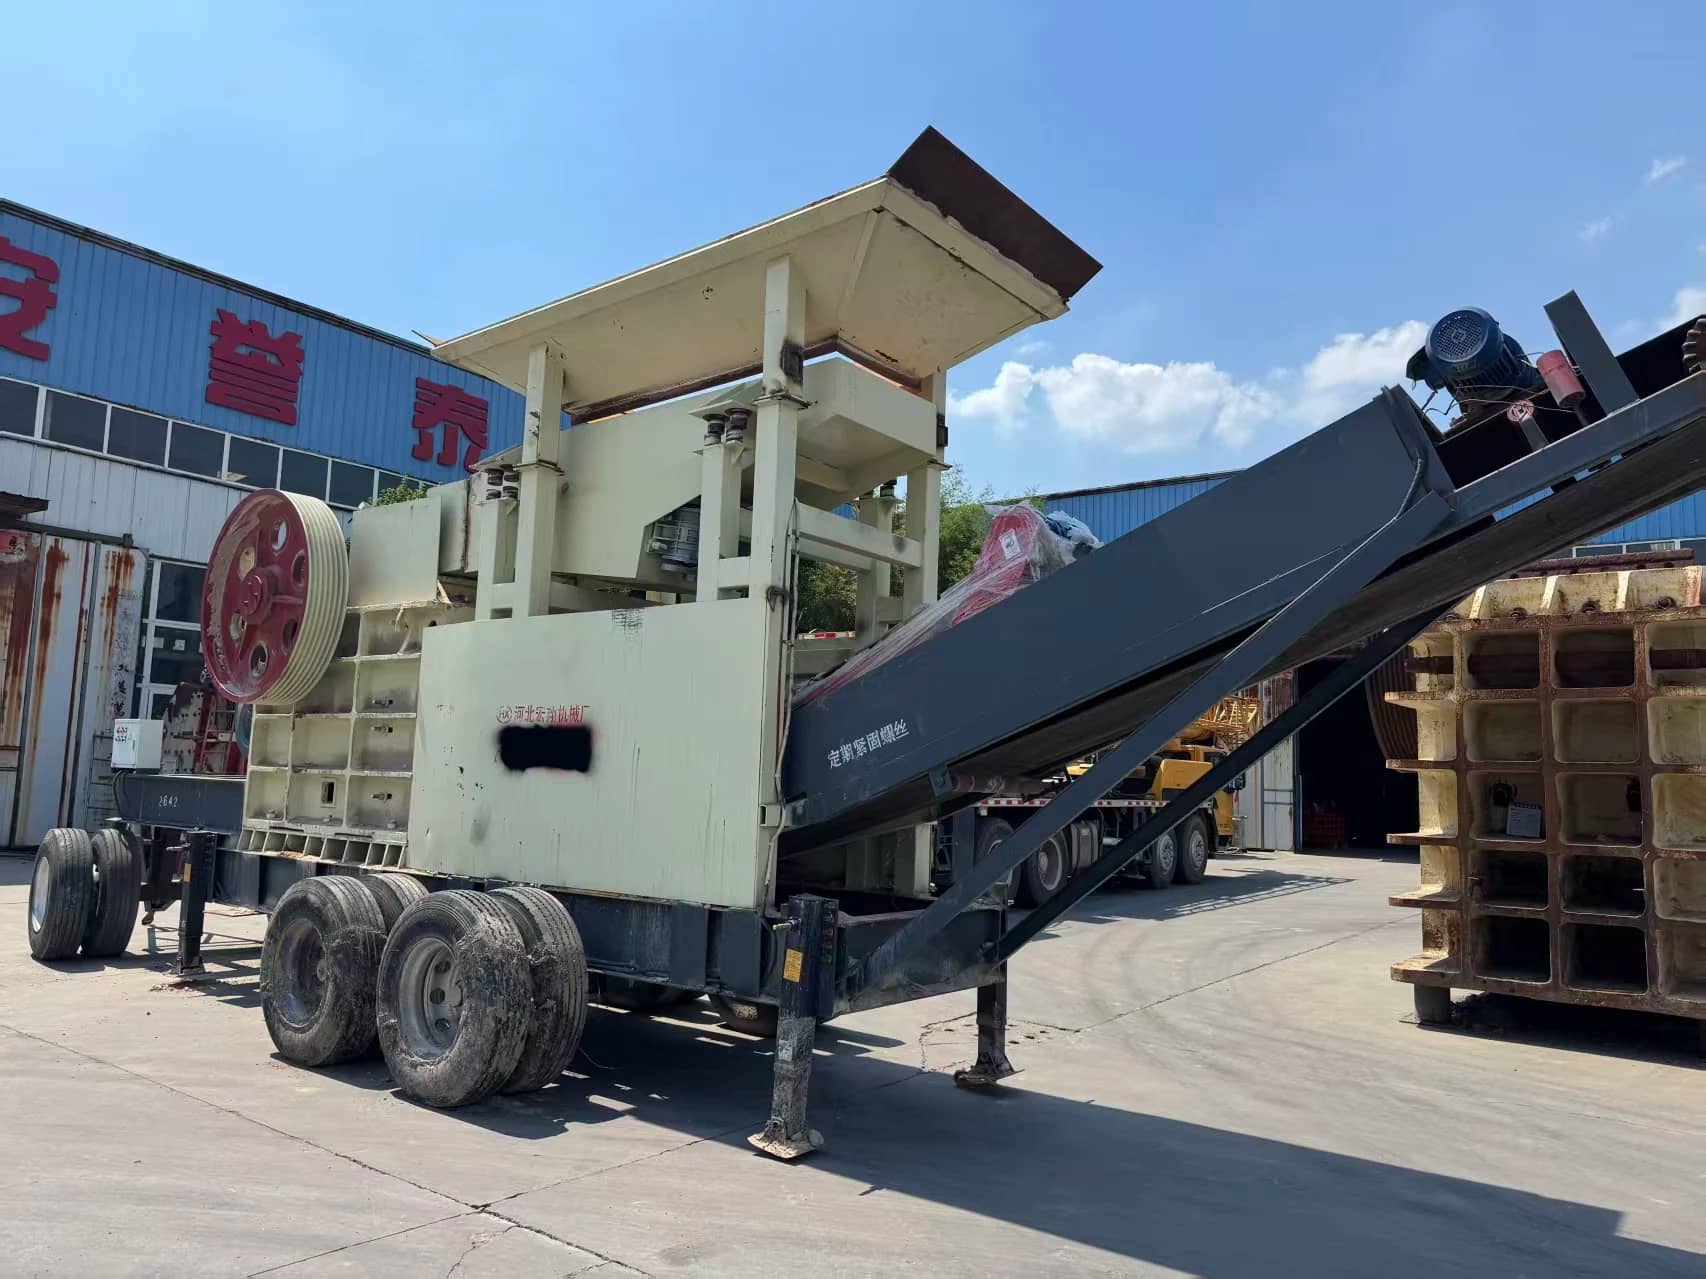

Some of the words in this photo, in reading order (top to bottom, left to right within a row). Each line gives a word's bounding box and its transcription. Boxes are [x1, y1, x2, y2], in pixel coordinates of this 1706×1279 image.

[827, 718, 909, 769] 定期紧固螺丝
